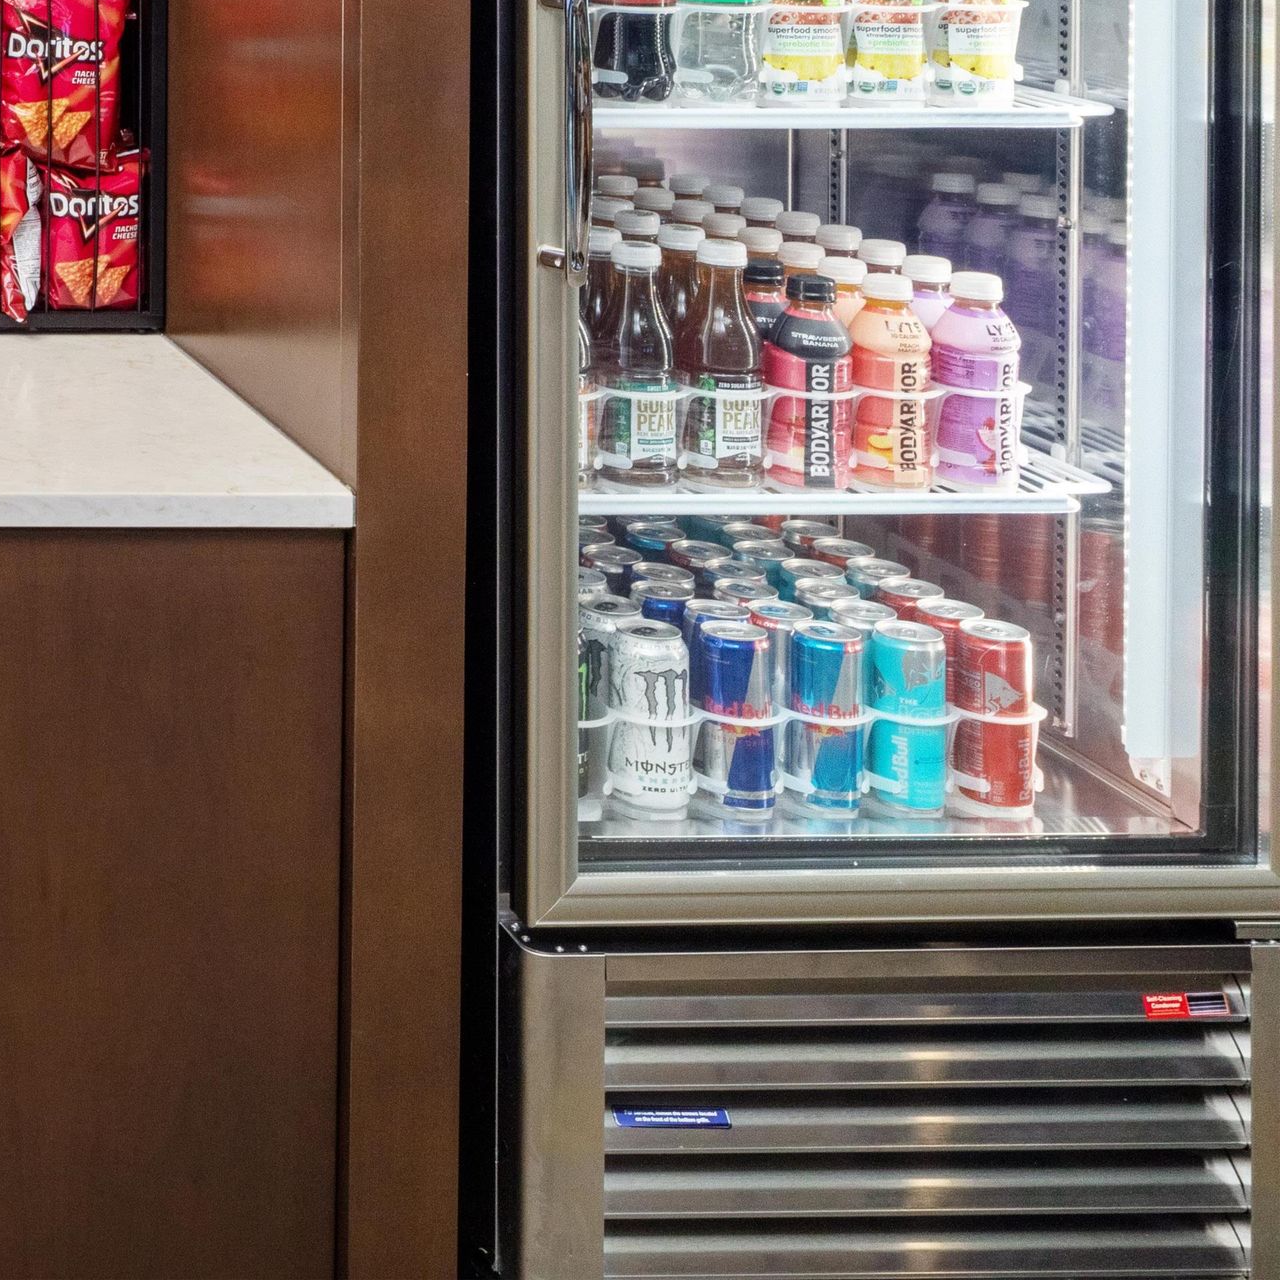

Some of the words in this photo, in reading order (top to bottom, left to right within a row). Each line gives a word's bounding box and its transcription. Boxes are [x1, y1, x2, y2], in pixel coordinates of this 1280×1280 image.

[768, 26, 811, 35] superfood
[856, 24, 901, 34] superfood
[8, 32, 104, 61] Doritos
[50, 192, 139, 217] Doritos
[803, 340, 839, 348] BANANA
[637, 414, 673, 432] PEAK
[722, 412, 759, 430] PEAK
[705, 695, 738, 715] Red
[792, 694, 824, 718] Red
[899, 697, 918, 705] THE
[898, 727, 939, 735] EDITION
